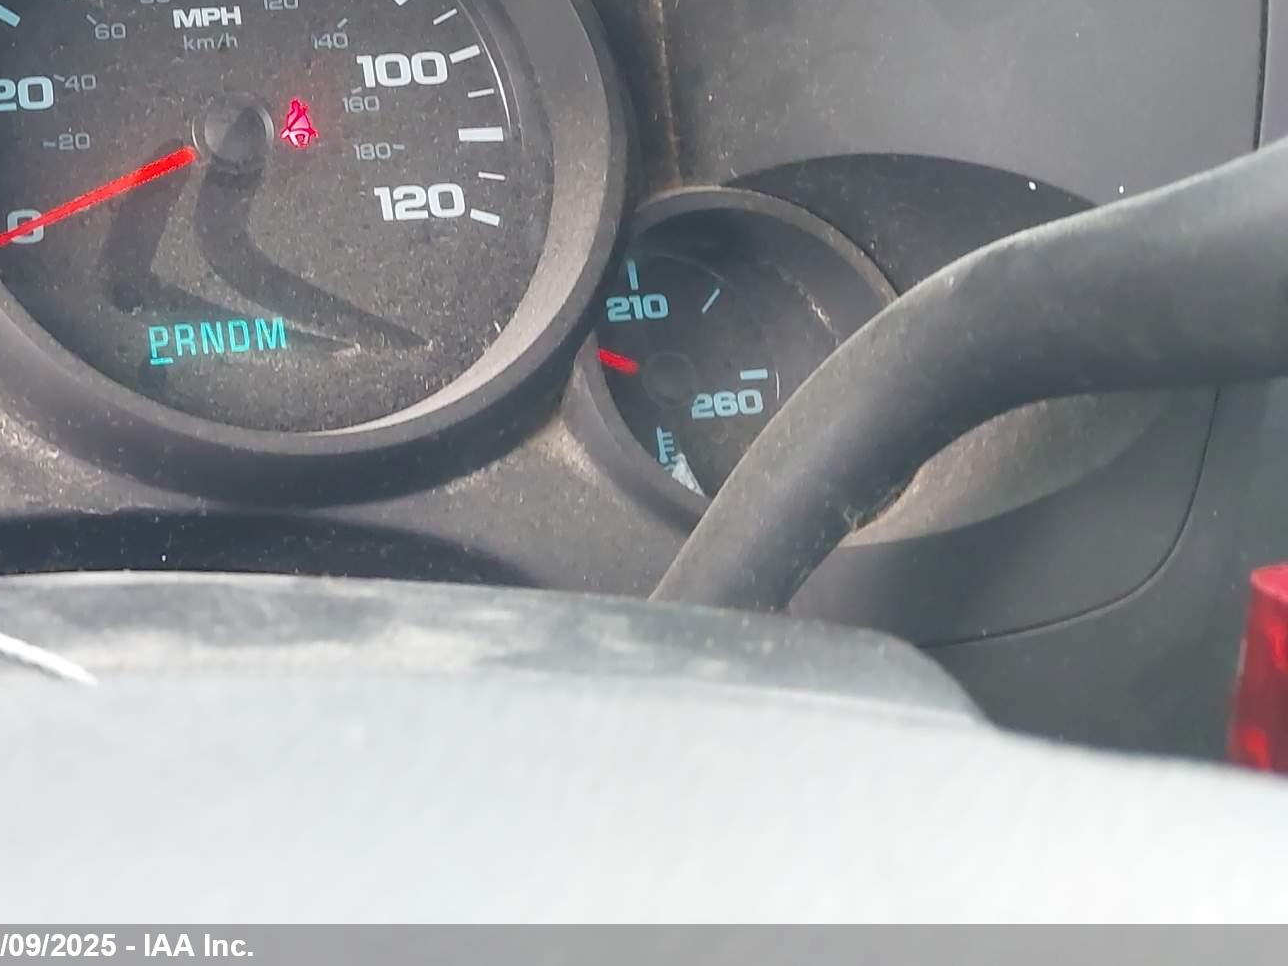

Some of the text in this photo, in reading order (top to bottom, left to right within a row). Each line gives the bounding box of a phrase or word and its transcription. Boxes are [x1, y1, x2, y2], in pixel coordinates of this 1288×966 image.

[172, 5, 242, 29] MPH
[94, 23, 126, 40] 60
[312, 32, 349, 50] 140
[183, 35, 239, 52] km/h
[356, 51, 449, 89] 100
[64, 74, 97, 92] 40
[342, 95, 380, 113] 160
[59, 133, 90, 150] 20
[353, 142, 391, 161] 180
[374, 182, 466, 222] 120
[7, 209, 45, 245] 0
[606, 293, 669, 322] 210
[148, 316, 287, 361] PRNDM
[691, 389, 763, 419] 260
